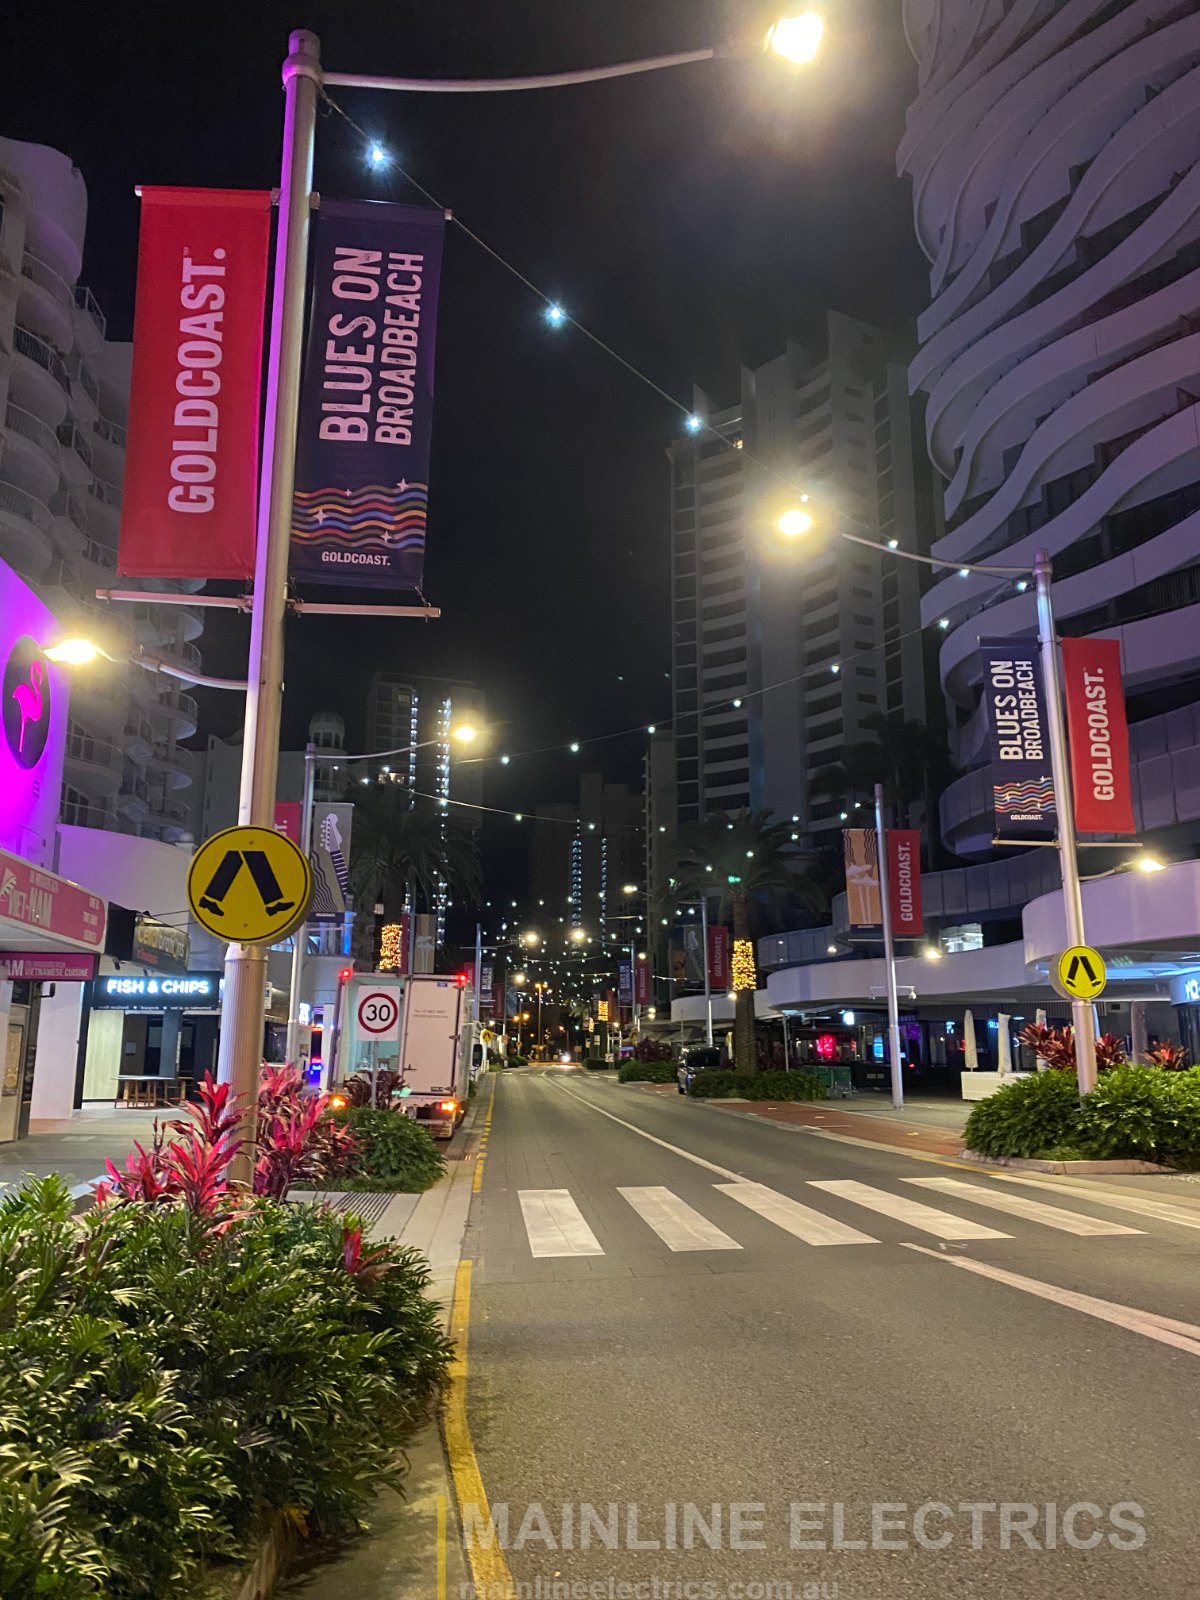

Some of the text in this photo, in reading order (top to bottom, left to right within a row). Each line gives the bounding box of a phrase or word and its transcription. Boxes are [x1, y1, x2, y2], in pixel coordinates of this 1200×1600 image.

[319, 247, 382, 442] BLUES ON
[375, 252, 424, 445] BROADBEACH
[321, 551, 391, 566] GOLDCOAST.
[990, 661, 1024, 760] BLUES ON
[1015, 661, 1044, 760] BROADBEACH
[1084, 667, 1115, 801] GOLDCOAST.
[898, 841, 914, 922] GOLDCOAST.
[25, 968, 89, 977] VIETNAMESE CUISINE
[107, 980, 209, 994] FISH & CHIPS
[366, 1003, 391, 1021] 30
